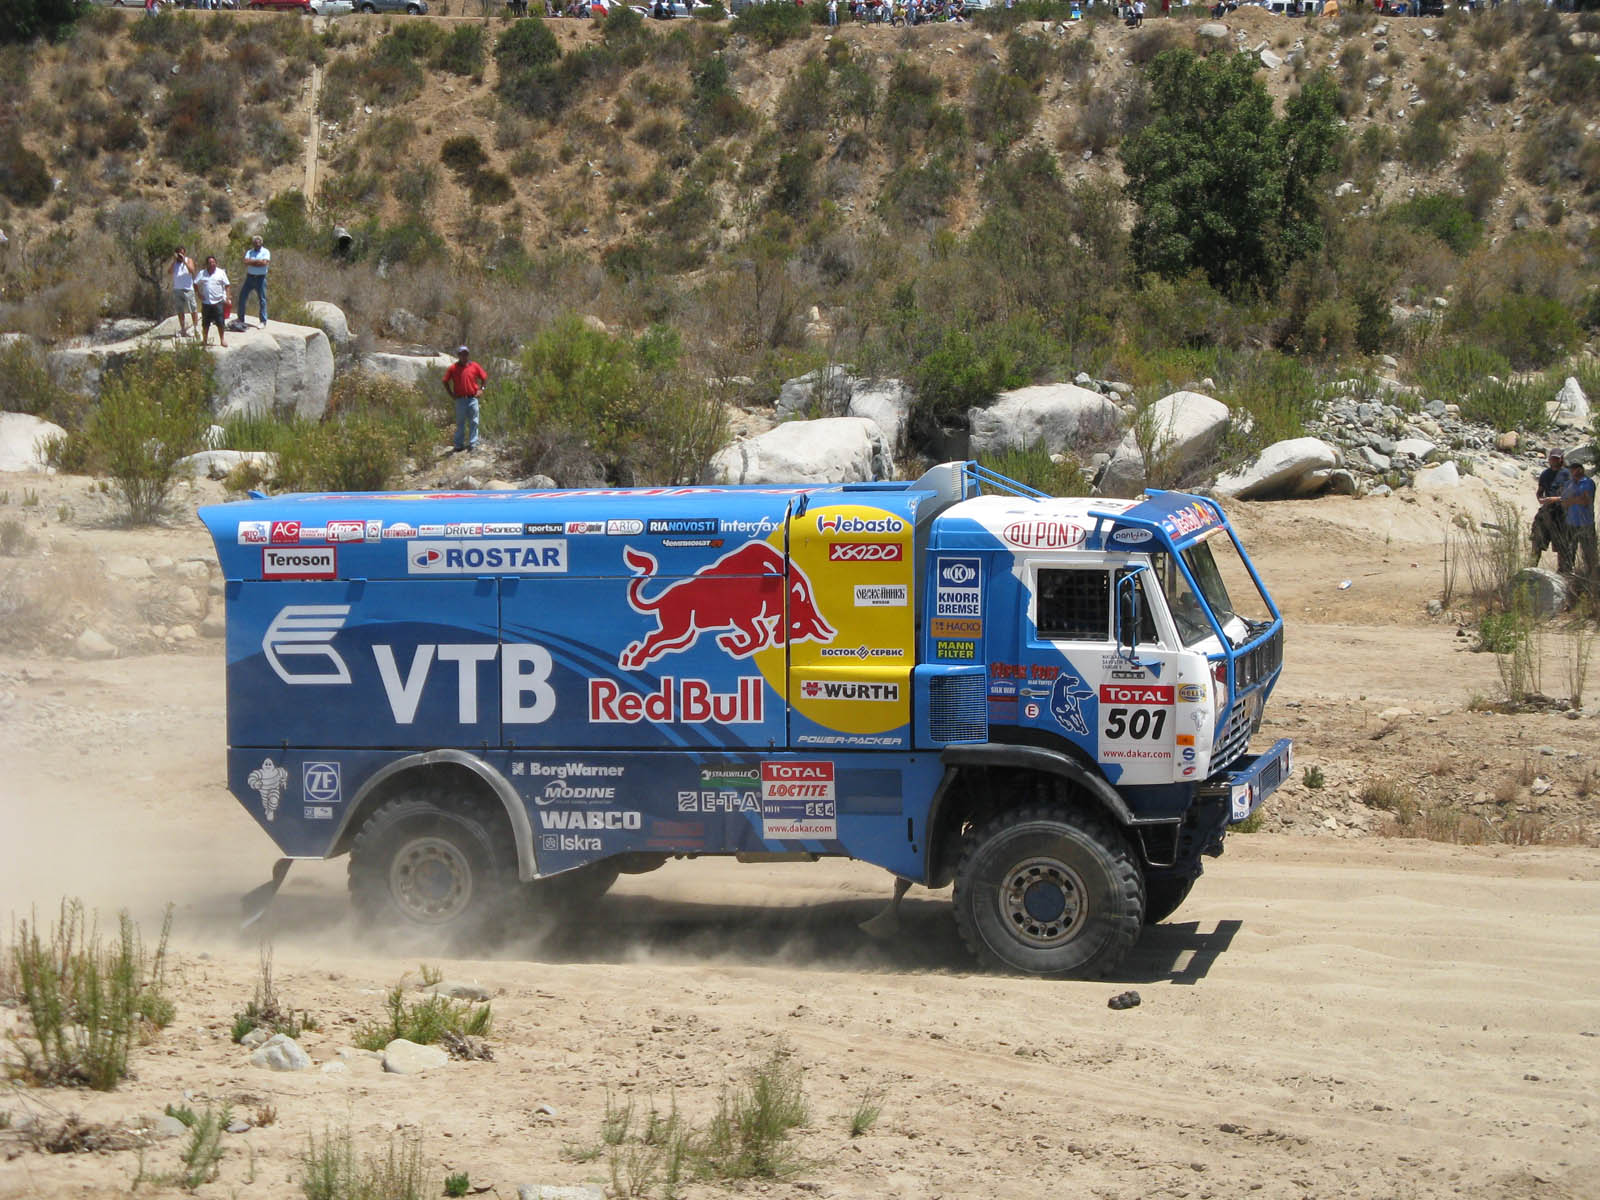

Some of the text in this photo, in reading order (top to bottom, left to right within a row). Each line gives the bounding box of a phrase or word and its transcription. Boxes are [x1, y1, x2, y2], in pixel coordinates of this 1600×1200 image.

[273, 522, 298, 536] AG
[528, 524, 562, 533] sports.ru
[721, 516, 779, 537] interfax
[817, 515, 904, 533] Webasto
[267, 553, 330, 566] Teroson
[446, 547, 561, 567] ROSTAR
[938, 592, 979, 603] KNORR
[938, 604, 979, 614] BREMSE
[938, 642, 974, 650] MANN
[938, 650, 974, 658] FILTER
[371, 643, 556, 724] VTB
[824, 683, 897, 699] WÜRTH
[588, 676, 764, 723] Red Bull
[1028, 706, 1036, 716] E
[1105, 708, 1167, 740] 501
[798, 736, 902, 744] POWER-PACKER
[1104, 749, 1171, 759] www.dakar.com
[530, 762, 624, 778] BorgWarner
[545, 787, 615, 798] MODINE
[768, 784, 827, 797] LOCTITE
[540, 811, 641, 829] WABCO
[768, 823, 832, 832] www.dakar.com
[560, 834, 602, 850] Iskra
